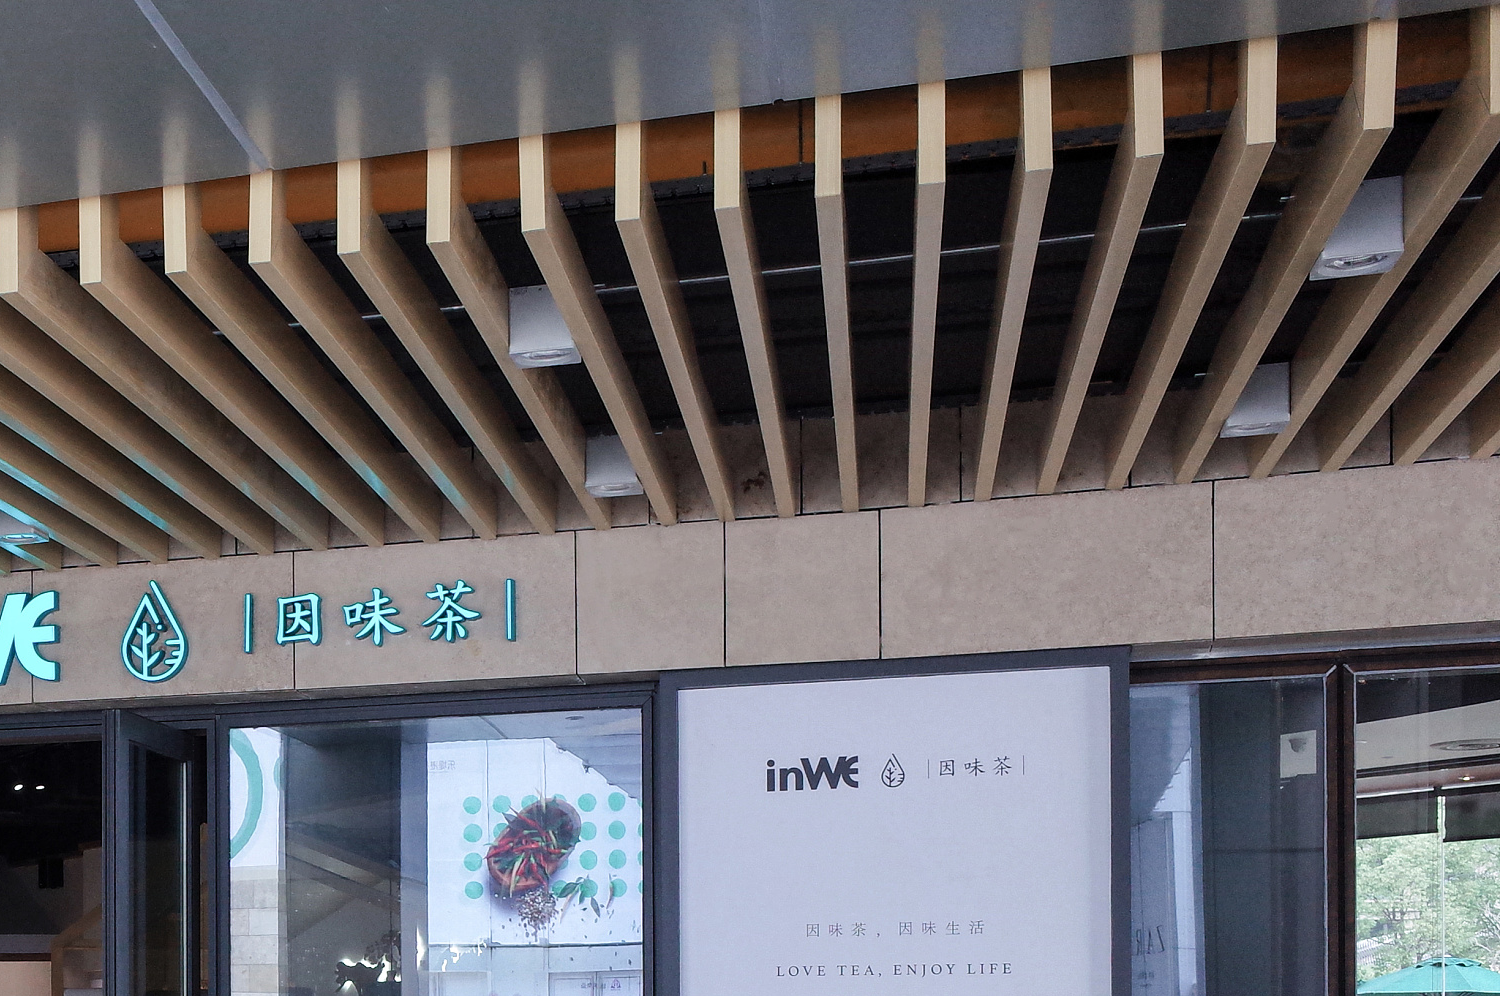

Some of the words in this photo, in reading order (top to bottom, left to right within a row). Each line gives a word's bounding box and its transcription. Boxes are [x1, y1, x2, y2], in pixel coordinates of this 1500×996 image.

[276, 579, 482, 647] 因味茶
[766, 755, 859, 792] inWE
[939, 756, 1013, 777] 因味茶
[776, 965, 826, 977] LOVE
[837, 964, 883, 978] TEA,
[893, 963, 956, 978] ENJOY
[966, 962, 1013, 976] LIFE
